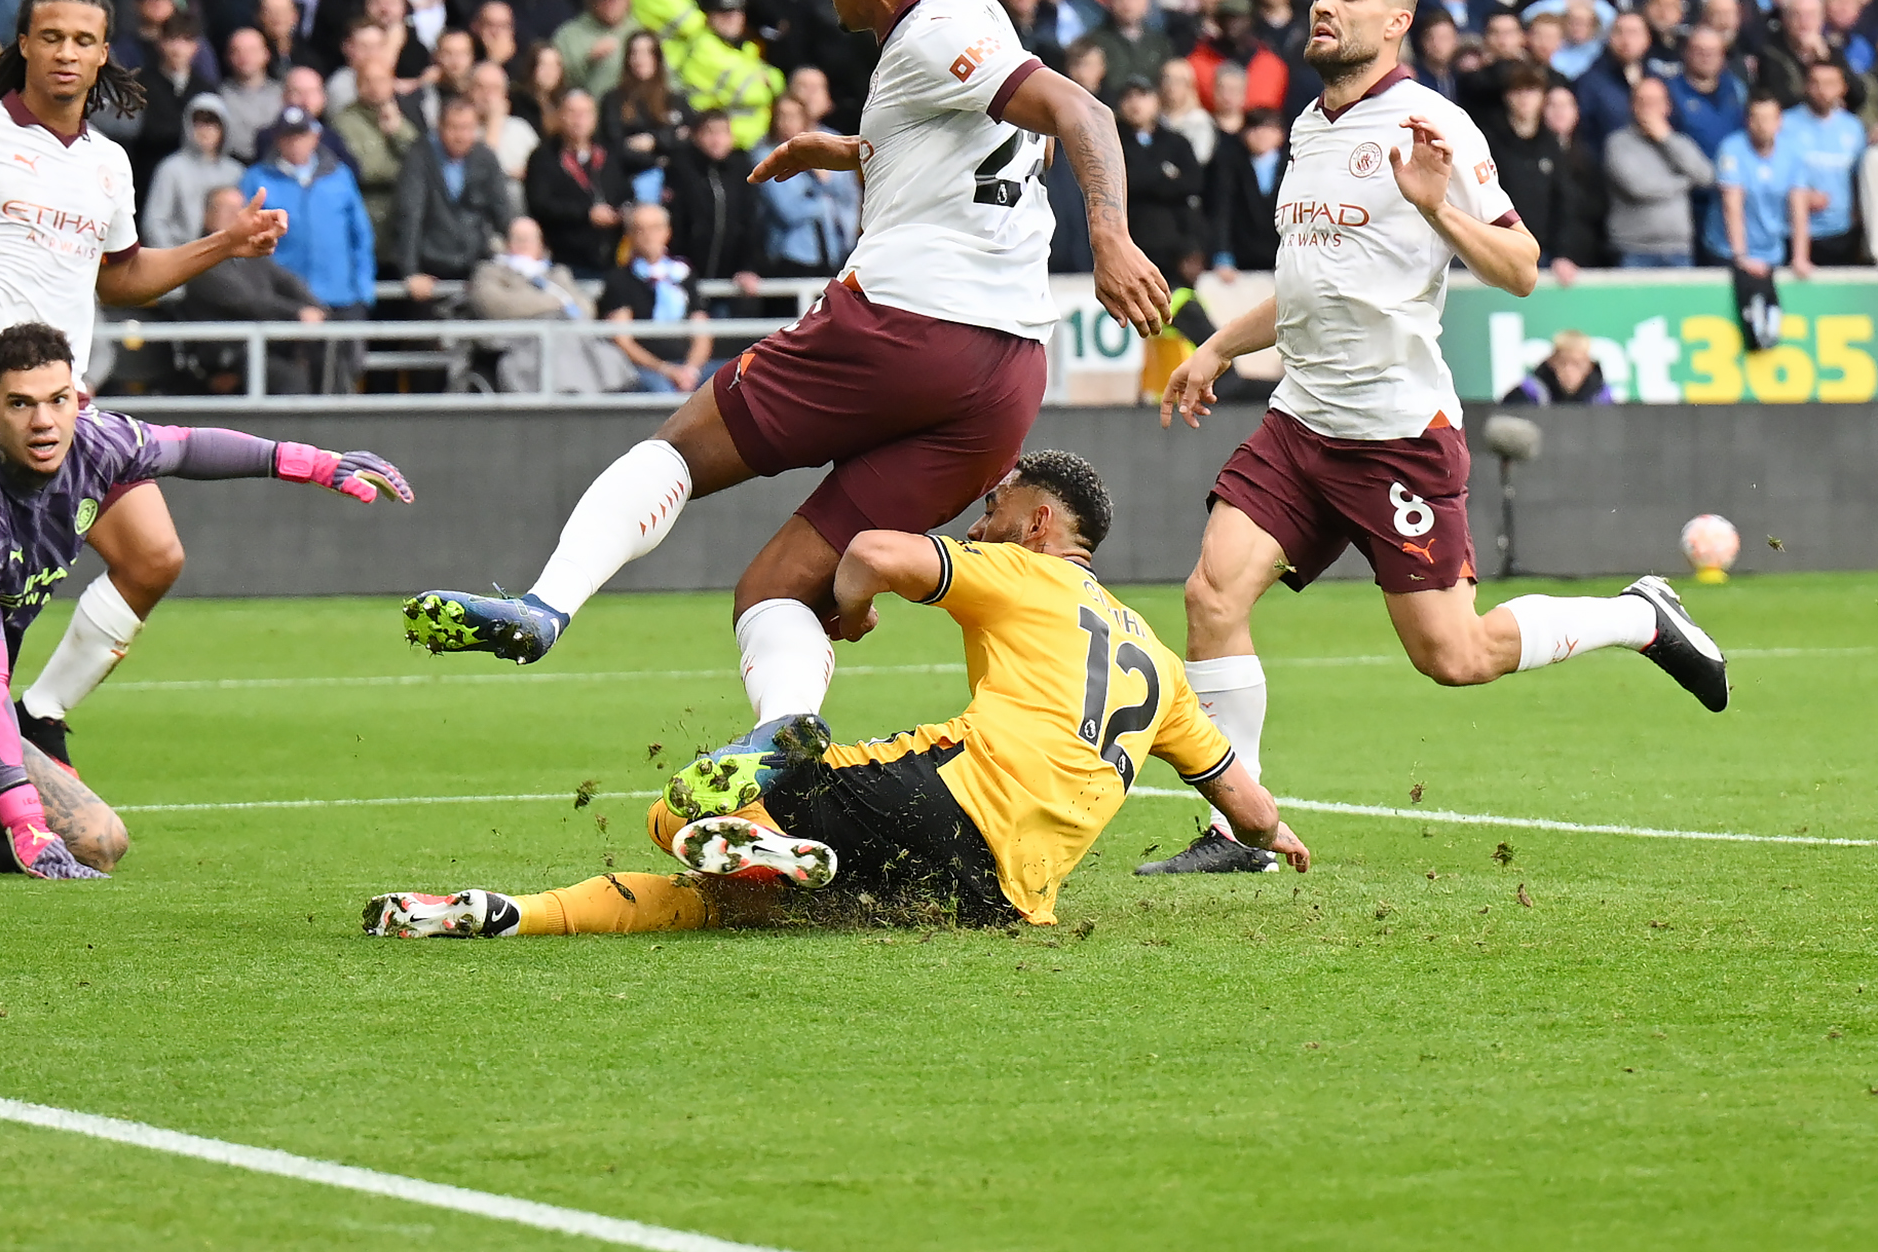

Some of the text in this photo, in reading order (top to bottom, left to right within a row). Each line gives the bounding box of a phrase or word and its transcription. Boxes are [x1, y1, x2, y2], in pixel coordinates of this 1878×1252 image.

[1282, 232, 1343, 248] RWAYS
[1067, 309, 1131, 359] 10
[1389, 481, 1436, 538] 8
[1077, 603, 1161, 796] 12
